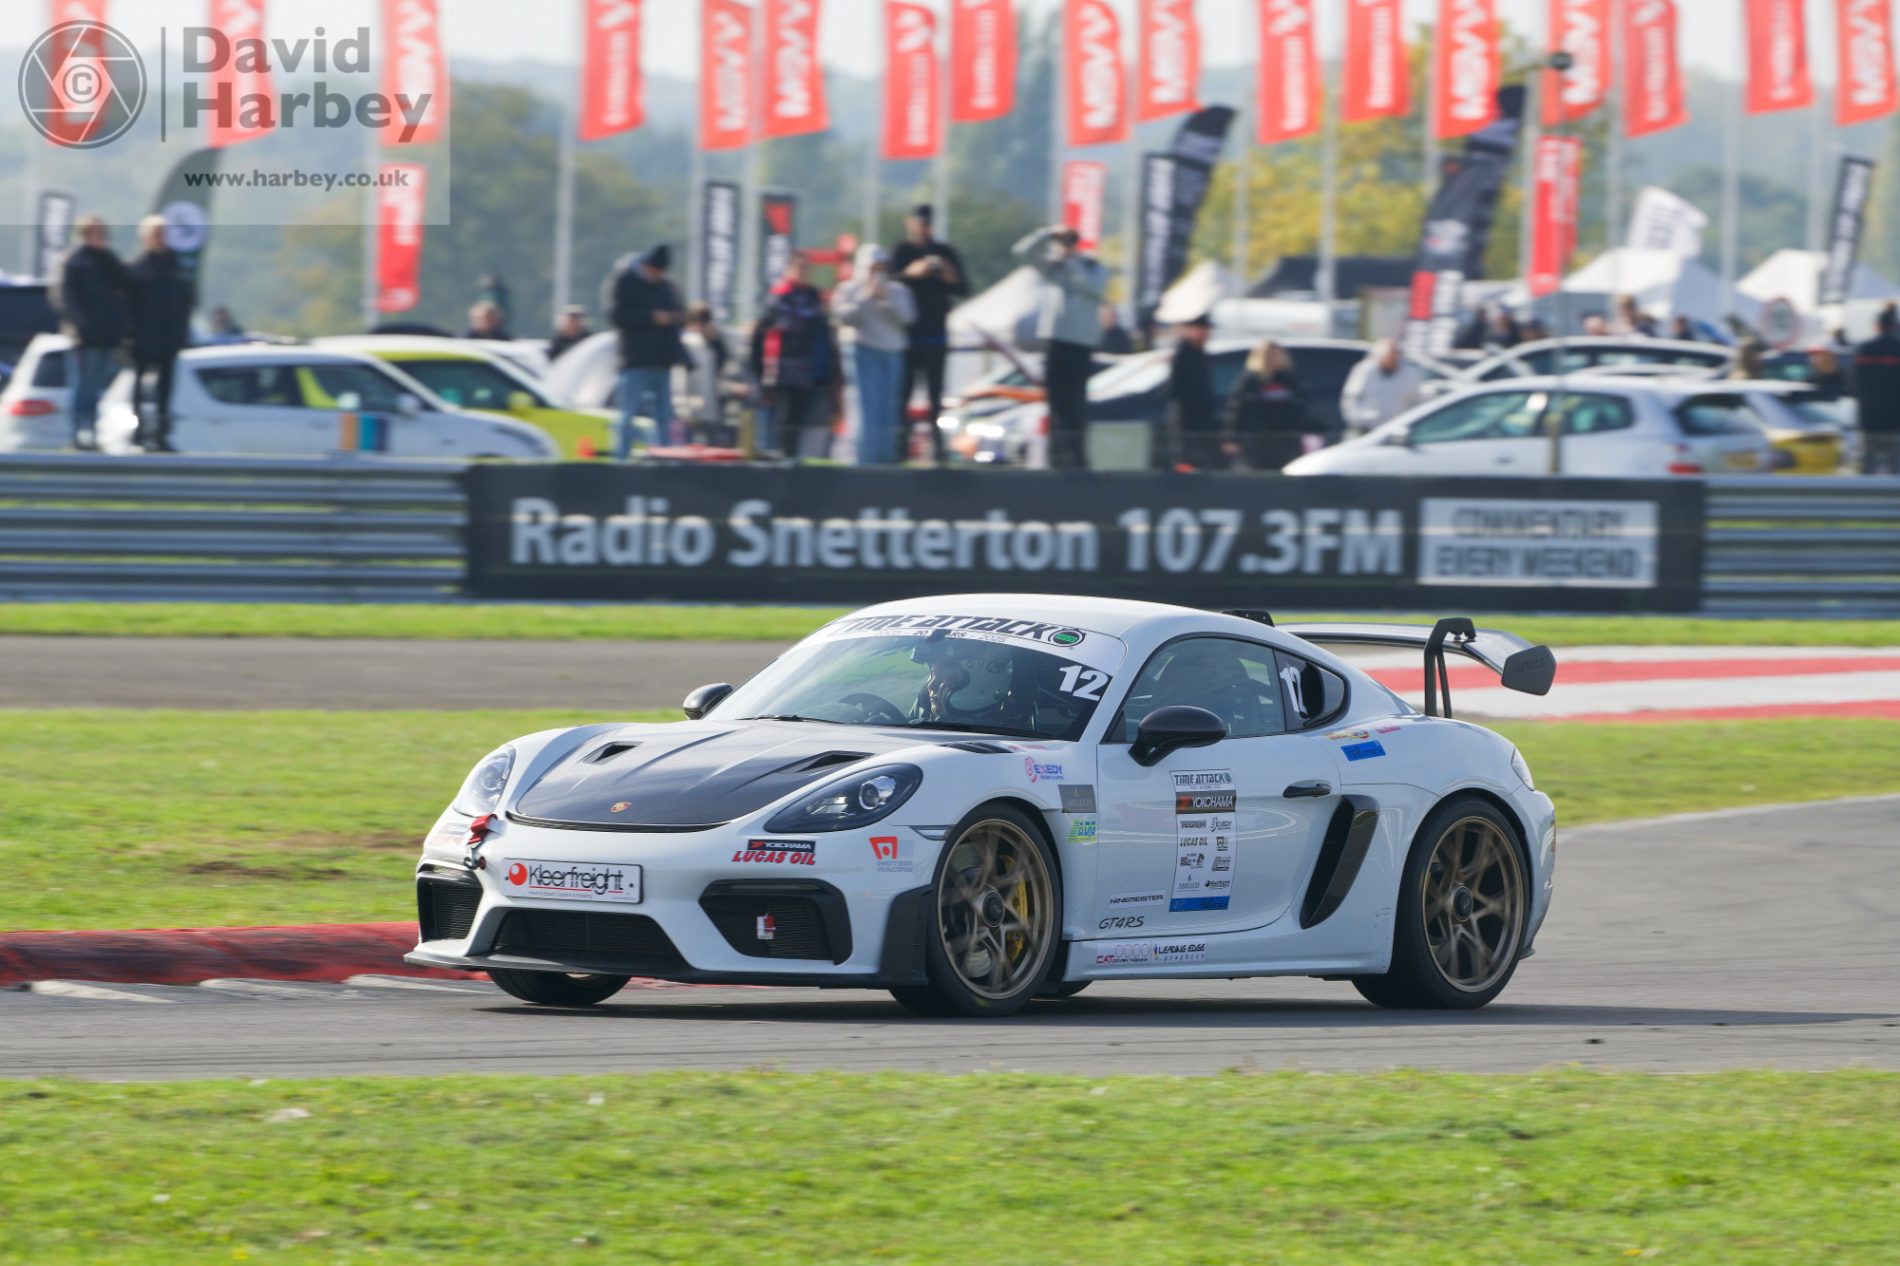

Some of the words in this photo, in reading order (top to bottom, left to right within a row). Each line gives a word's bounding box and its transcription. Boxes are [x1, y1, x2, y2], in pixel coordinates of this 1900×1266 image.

[511, 496, 713, 568] Radio
[729, 499, 1099, 571] Snetterton
[1117, 508, 1405, 576] 107.3FM
[910, 615, 1055, 640] ATTACK
[1059, 665, 1110, 701] 12
[1033, 764, 1063, 775] EXEDY
[1174, 774, 1194, 786] TIME
[1195, 772, 1225, 784] ATTACK
[1192, 795, 1233, 808] YOKOHAMA
[764, 842, 812, 850] YOKOHAMA
[732, 850, 788, 864] LUCAS
[789, 852, 817, 865] OIL
[529, 864, 624, 895] Kleerfreight
[1098, 915, 1145, 930] GT4RS
[1159, 944, 1186, 954] LEADING
[1188, 943, 1206, 952] EDGE
[1096, 955, 1114, 964] CAT
